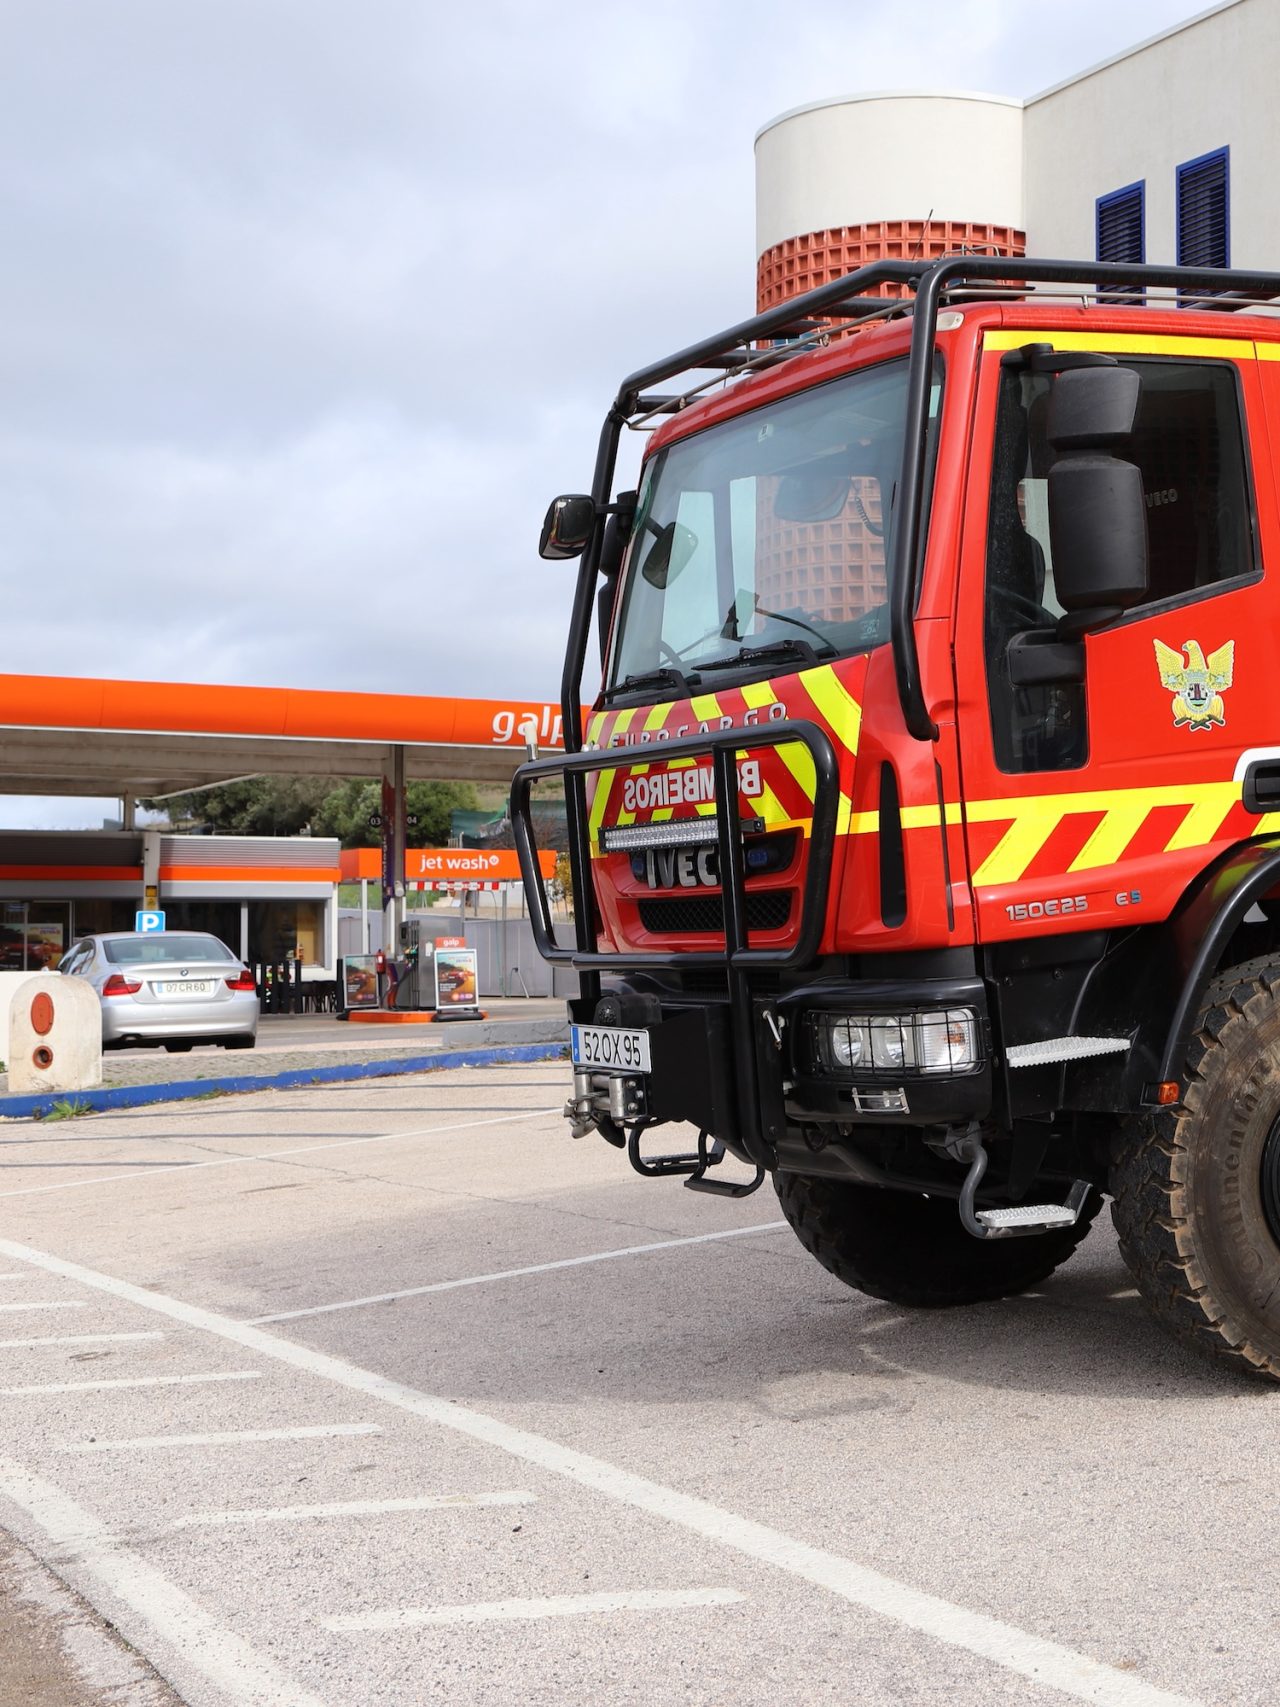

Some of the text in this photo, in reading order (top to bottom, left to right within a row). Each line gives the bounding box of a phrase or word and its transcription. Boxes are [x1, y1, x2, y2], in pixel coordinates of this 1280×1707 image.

[1144, 489, 1177, 508] VECO
[370, 817, 381, 825] 03
[406, 816, 417, 824] 04
[420, 855, 489, 872] jet wash
[646, 846, 745, 888] IVEC
[1005, 896, 1089, 920] 150E25
[141, 914, 159, 932] P
[443, 939, 460, 947] galp
